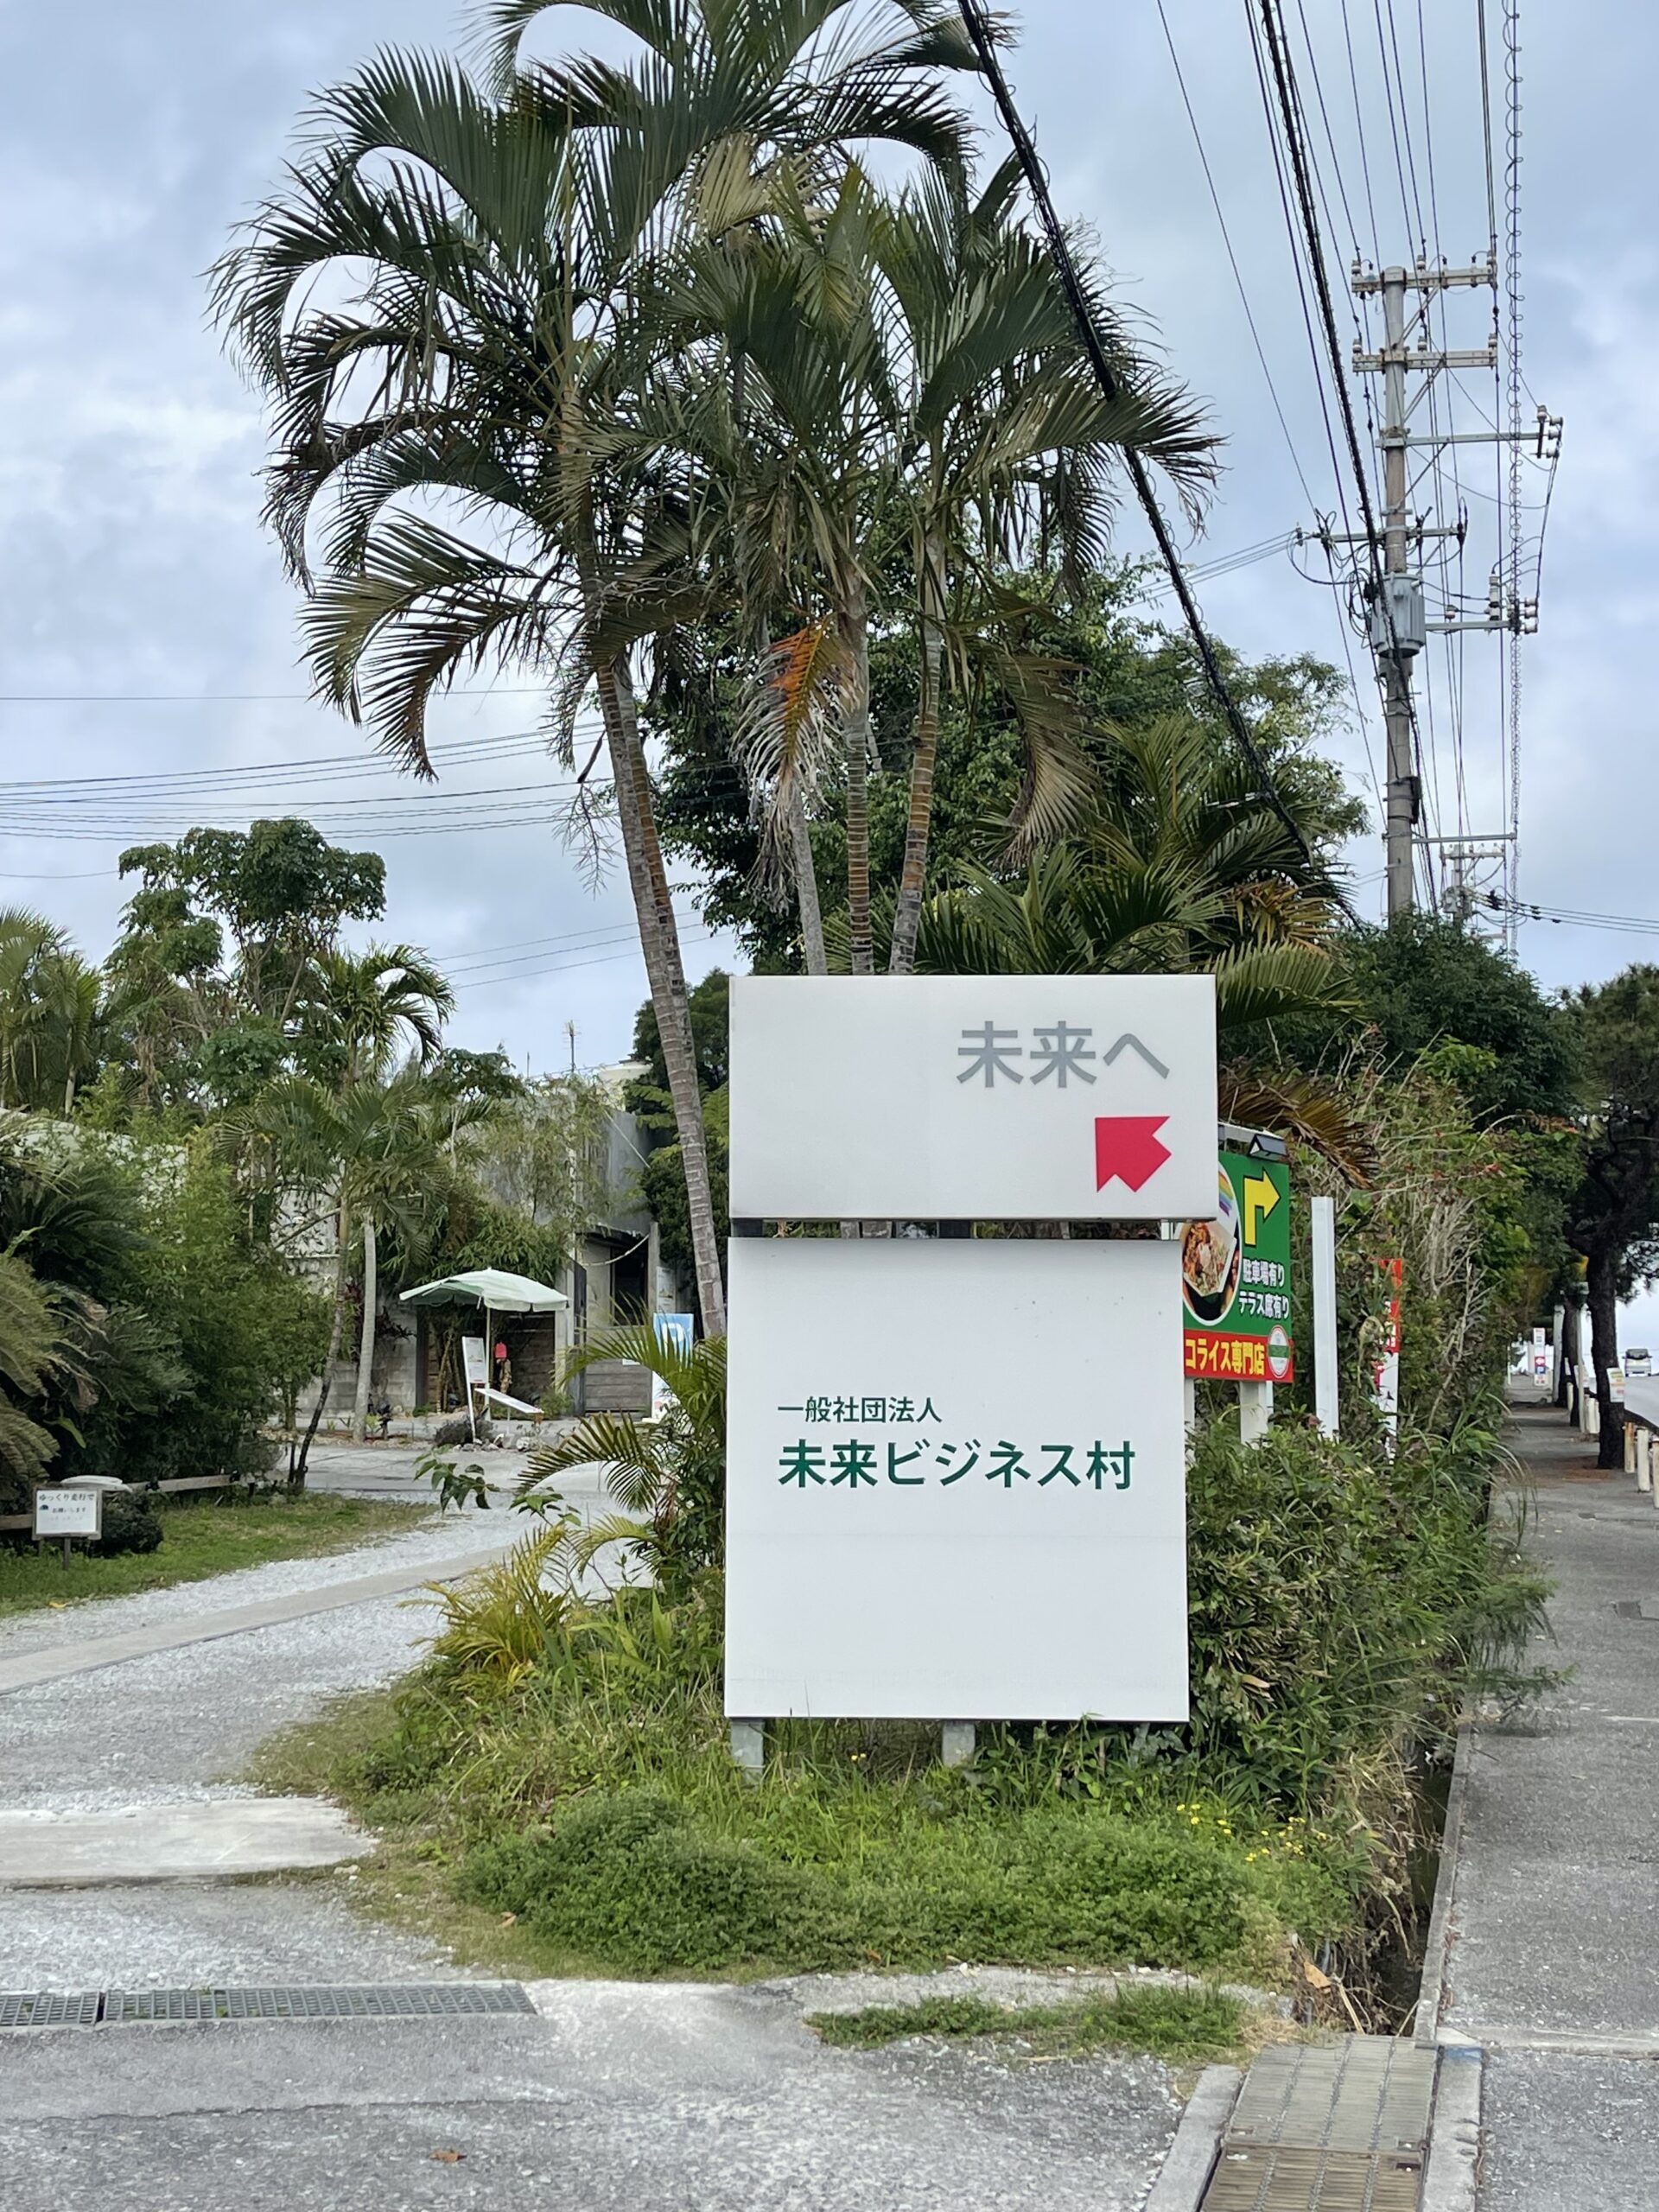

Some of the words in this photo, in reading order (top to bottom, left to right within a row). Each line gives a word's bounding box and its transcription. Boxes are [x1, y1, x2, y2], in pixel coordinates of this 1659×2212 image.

[956, 1020, 1170, 1089] 未来へ
[1242, 1259, 1286, 1287] 駐車場有り
[1238, 1290, 1290, 1319] テラス席有り
[777, 1395, 943, 1424] 一般社団法人
[778, 1438, 1136, 1491] 未来ビジネス村
